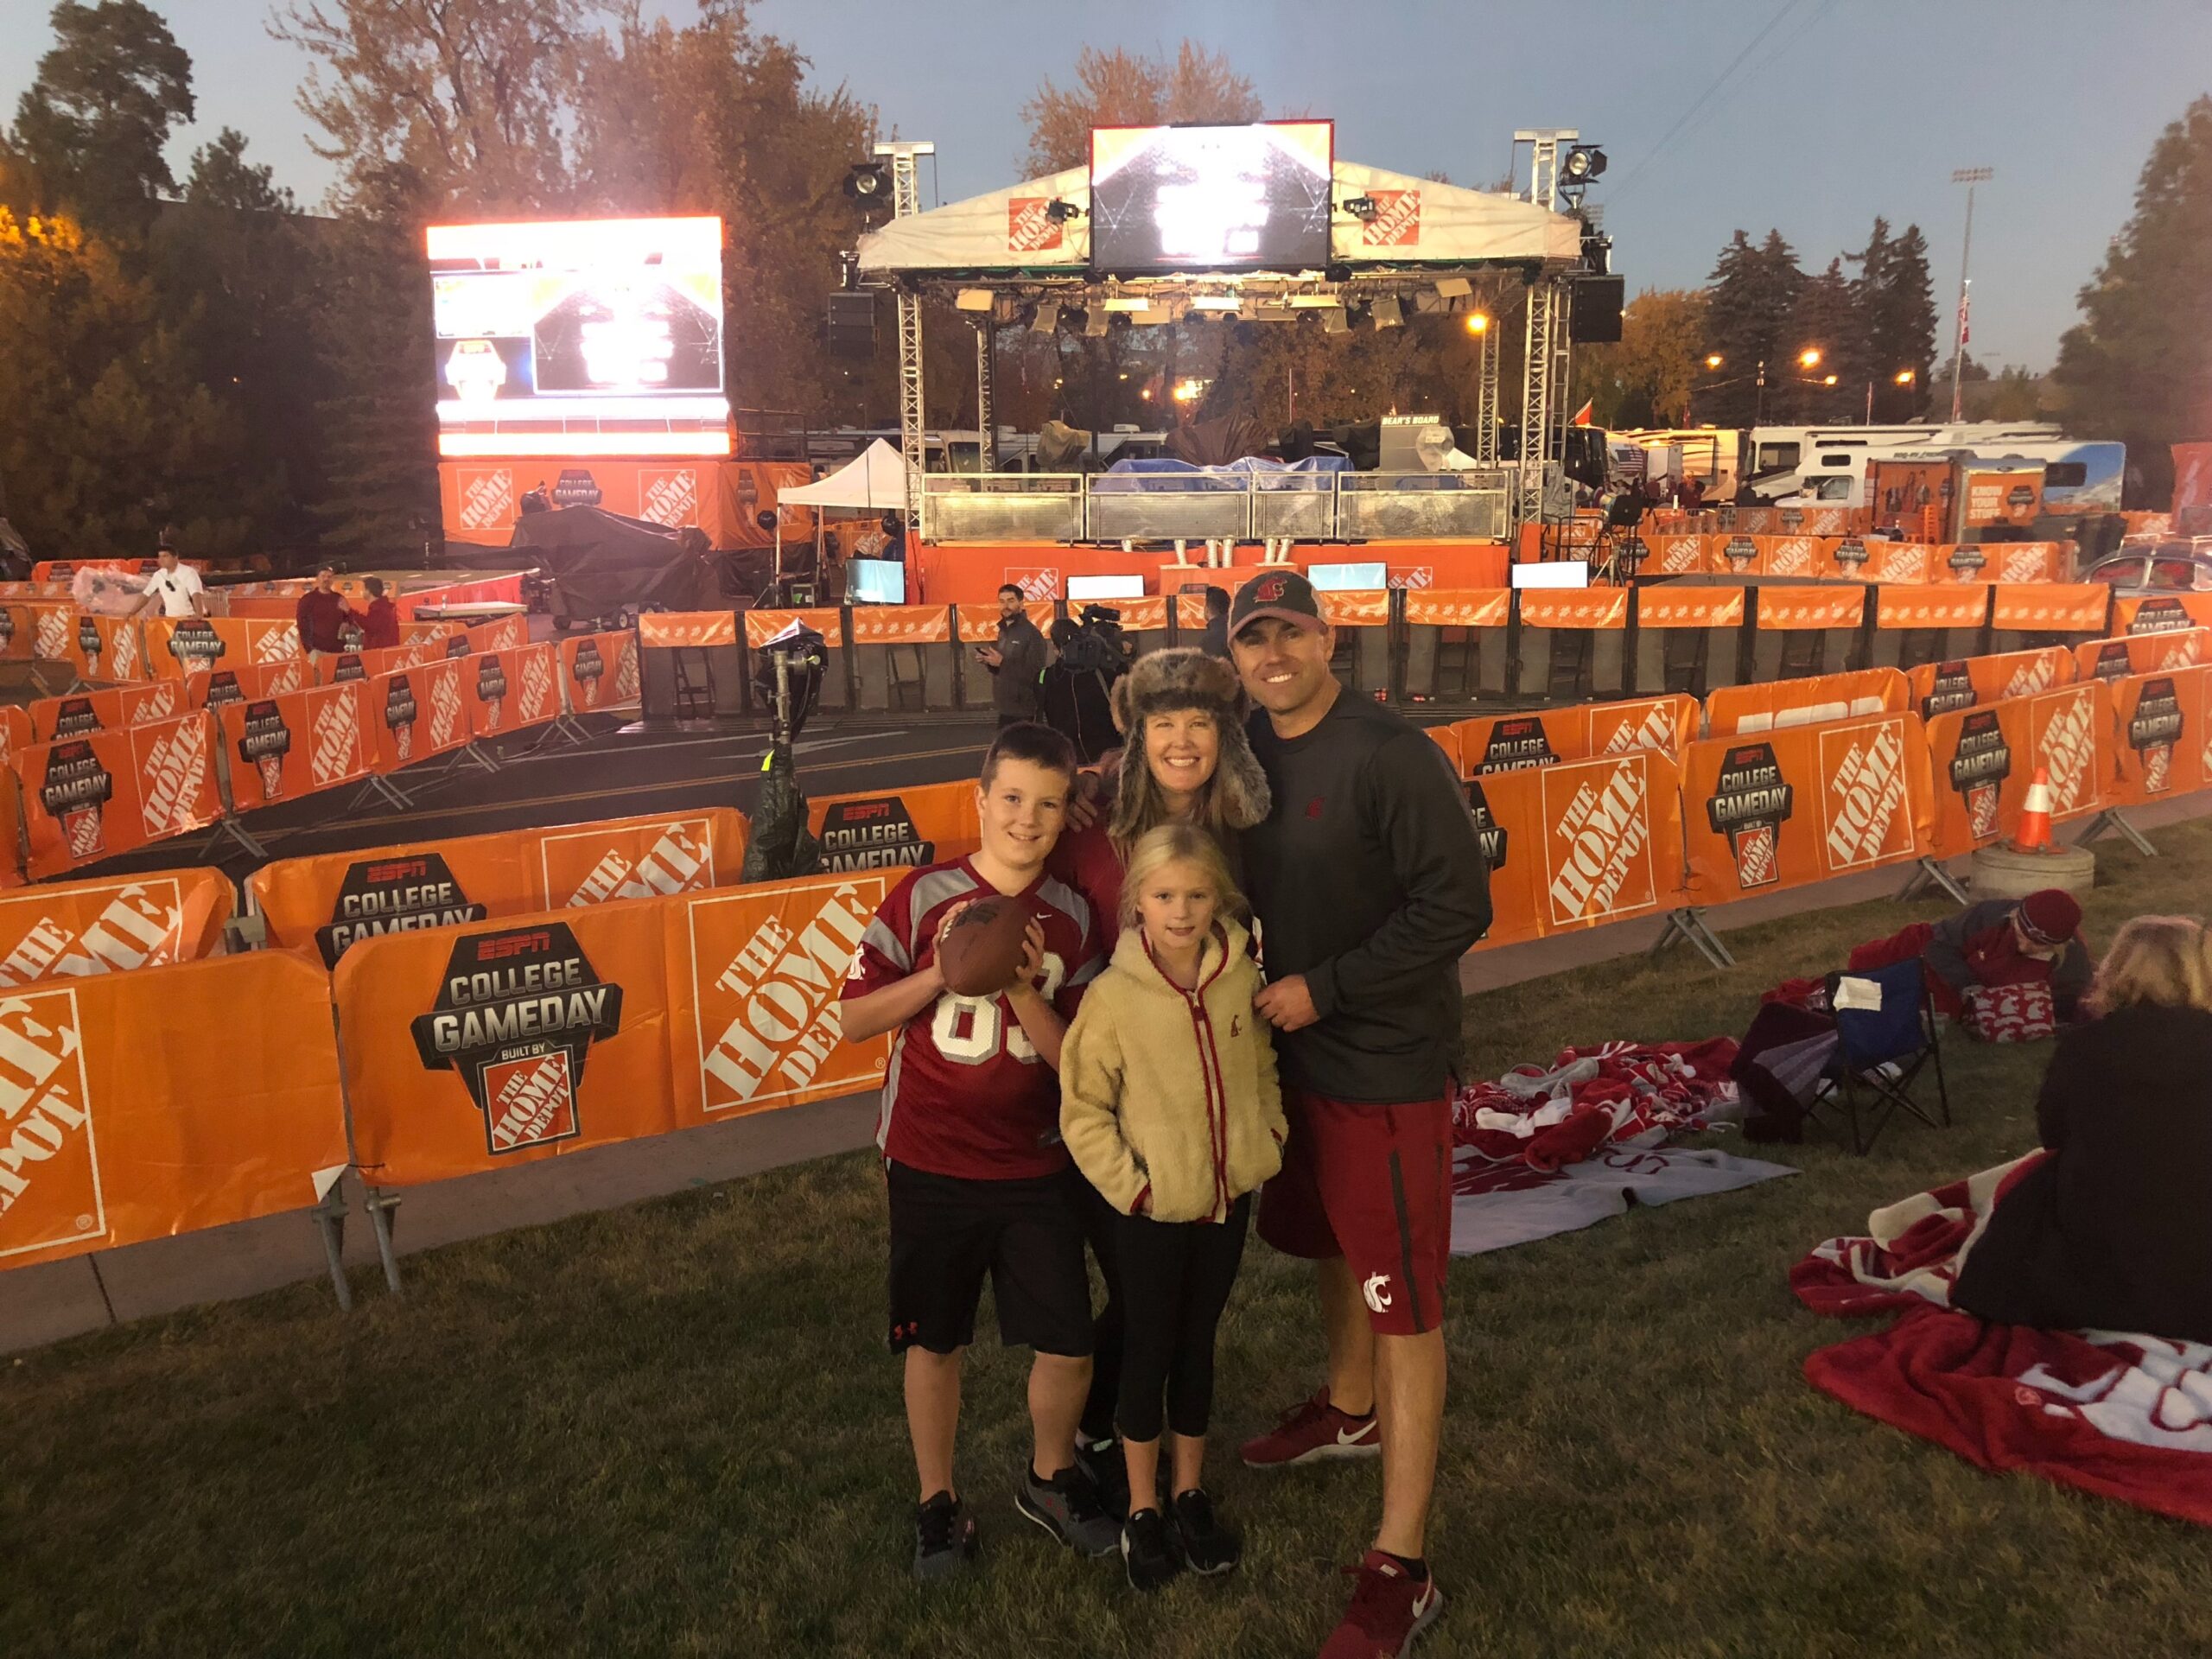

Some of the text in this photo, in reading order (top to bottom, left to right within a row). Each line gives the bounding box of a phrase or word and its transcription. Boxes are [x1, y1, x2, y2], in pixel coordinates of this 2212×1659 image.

[1363, 189, 1421, 245] HOME
[1376, 194, 1394, 218] HE
[1030, 221, 1059, 251] DEPO
[1382, 416, 1440, 425] BEAR'S BOARD
[460, 469, 512, 530] HOME
[465, 475, 486, 500] THE
[556, 489, 599, 500] GAMEDAY
[639, 469, 696, 524] HOME
[645, 477, 668, 502] THE
[1971, 486, 2003, 496] KNOW
[1971, 497, 1999, 508] YOUR
[481, 491, 512, 529] DEPOT
[1662, 535, 1700, 572] HOME
[1770, 537, 1812, 574] HOME
[1016, 574, 1033, 590] HE
[1023, 568, 1058, 601] OME
[1387, 573, 1405, 588] HE
[1397, 567, 1432, 588] ME
[170, 641, 222, 653] GAMEDAY
[518, 646, 550, 720] HOME
[2019, 652, 2056, 696] ME
[146, 685, 174, 721] ME
[313, 698, 334, 737] THE
[246, 715, 281, 733] COLLEGE
[312, 685, 357, 784] HOME
[1502, 721, 1534, 735] ESPN
[1626, 702, 1675, 751] ME
[1960, 729, 1999, 754] COLLEGE
[2038, 706, 2067, 756] THE
[143, 734, 169, 779] THE
[246, 730, 287, 756] GAMEDAY
[333, 715, 359, 779] DEPOT
[1490, 738, 1545, 760] COLLEGE
[1734, 748, 1764, 765] ESPN
[49, 757, 97, 781] COLLEGE
[143, 717, 205, 832] HOME
[1722, 766, 1777, 792] COLLEGE
[1831, 741, 1865, 798] THE
[1954, 747, 2008, 781] GAMEDAY
[45, 773, 107, 807] GAMEDAY
[1715, 786, 1787, 822] GAMEDAY
[1827, 721, 1904, 864] HOME
[843, 802, 890, 821] ESPN
[1555, 780, 1599, 843] THE
[1861, 769, 1904, 858] DEPOT
[824, 822, 910, 851] COLLEGE
[1551, 758, 1646, 919] HOME
[1741, 836, 1757, 858] THE
[367, 860, 427, 883] ESPN
[613, 823, 712, 899] ME
[1592, 811, 1648, 913] DEPOT
[1740, 827, 1772, 884] HOME
[565, 848, 633, 908] THE
[344, 881, 454, 918] COLLEGE
[52, 884, 183, 977] ME
[332, 907, 474, 957] GAMEDAY
[477, 931, 551, 961] ESPN
[714, 914, 794, 1000] THE
[450, 957, 582, 1006] COLLEGE
[703, 882, 879, 1101] HOME
[433, 988, 607, 1052] GAMEDAY
[778, 982, 845, 1089] DEP
[501, 1042, 545, 1060] BUILT BY
[493, 1052, 568, 1146] HOME
[496, 1069, 529, 1106] THE
[524, 1082, 570, 1141] DEPOT
[0, 1084, 86, 1217] POT
